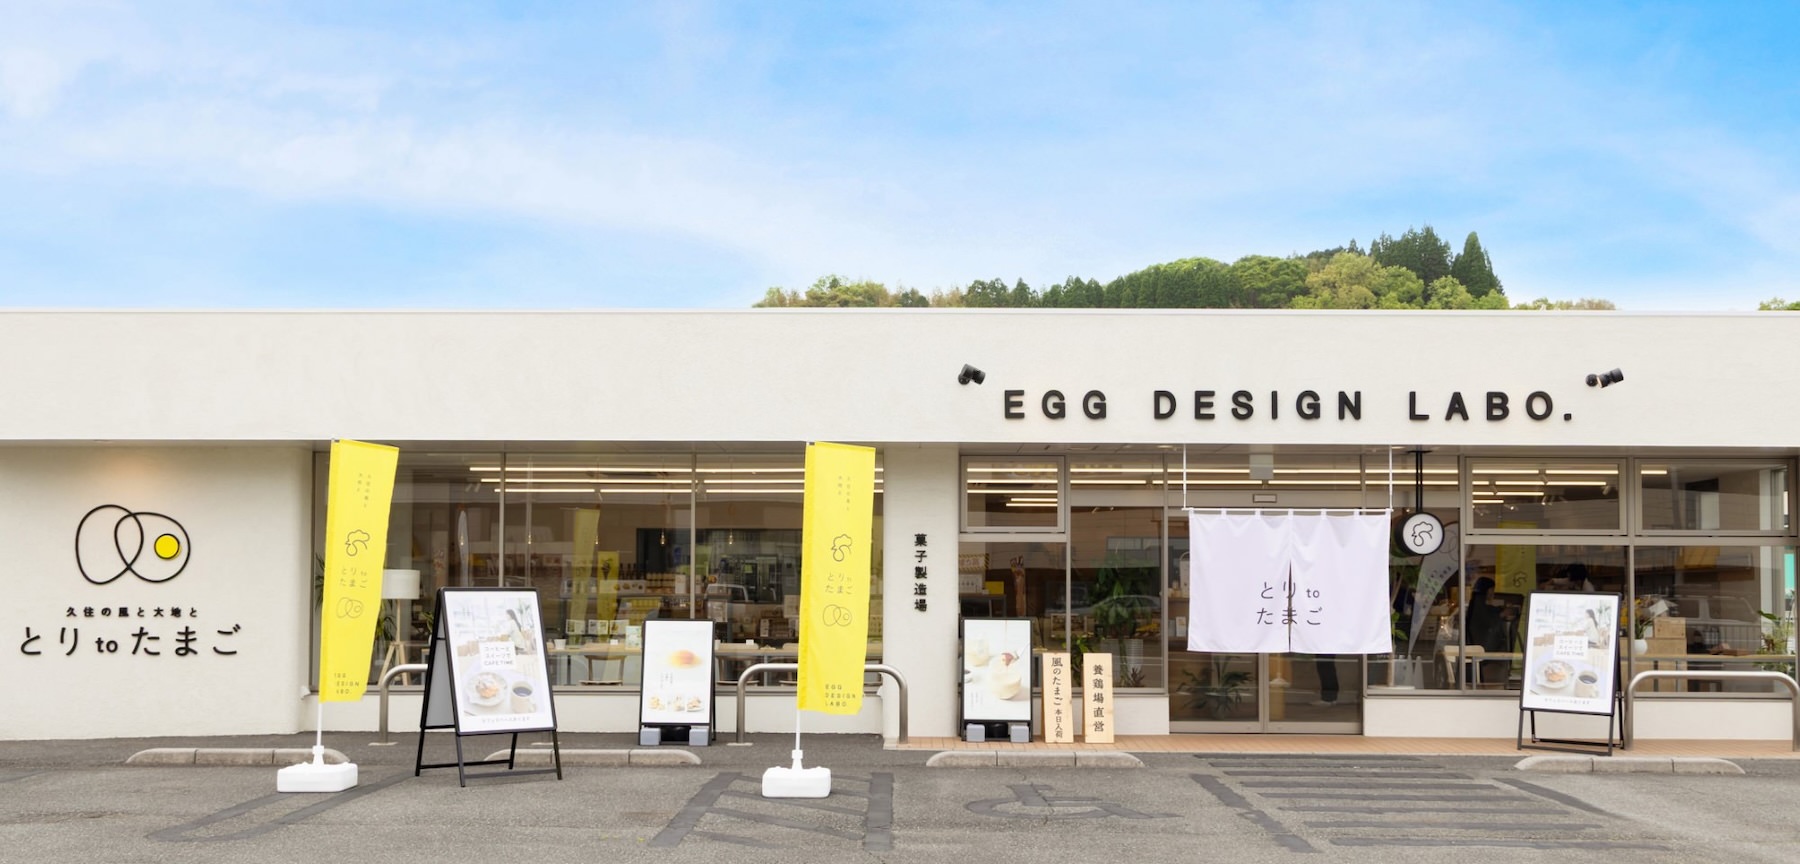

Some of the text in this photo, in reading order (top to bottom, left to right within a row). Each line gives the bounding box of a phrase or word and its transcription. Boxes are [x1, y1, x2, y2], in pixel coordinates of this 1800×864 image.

[1004, 389, 1572, 423] EGG DESIGN LABO.
[914, 533, 928, 613] 菓子製造場
[1260, 581, 1320, 600] とり to
[67, 606, 197, 619] 久住の風と大地と
[1257, 607, 1323, 626] たまご
[20, 626, 79, 657] とり
[131, 623, 241, 657] たまご
[1051, 657, 1063, 706] 風のたまご
[1092, 664, 1105, 733] 養鶏場直営
